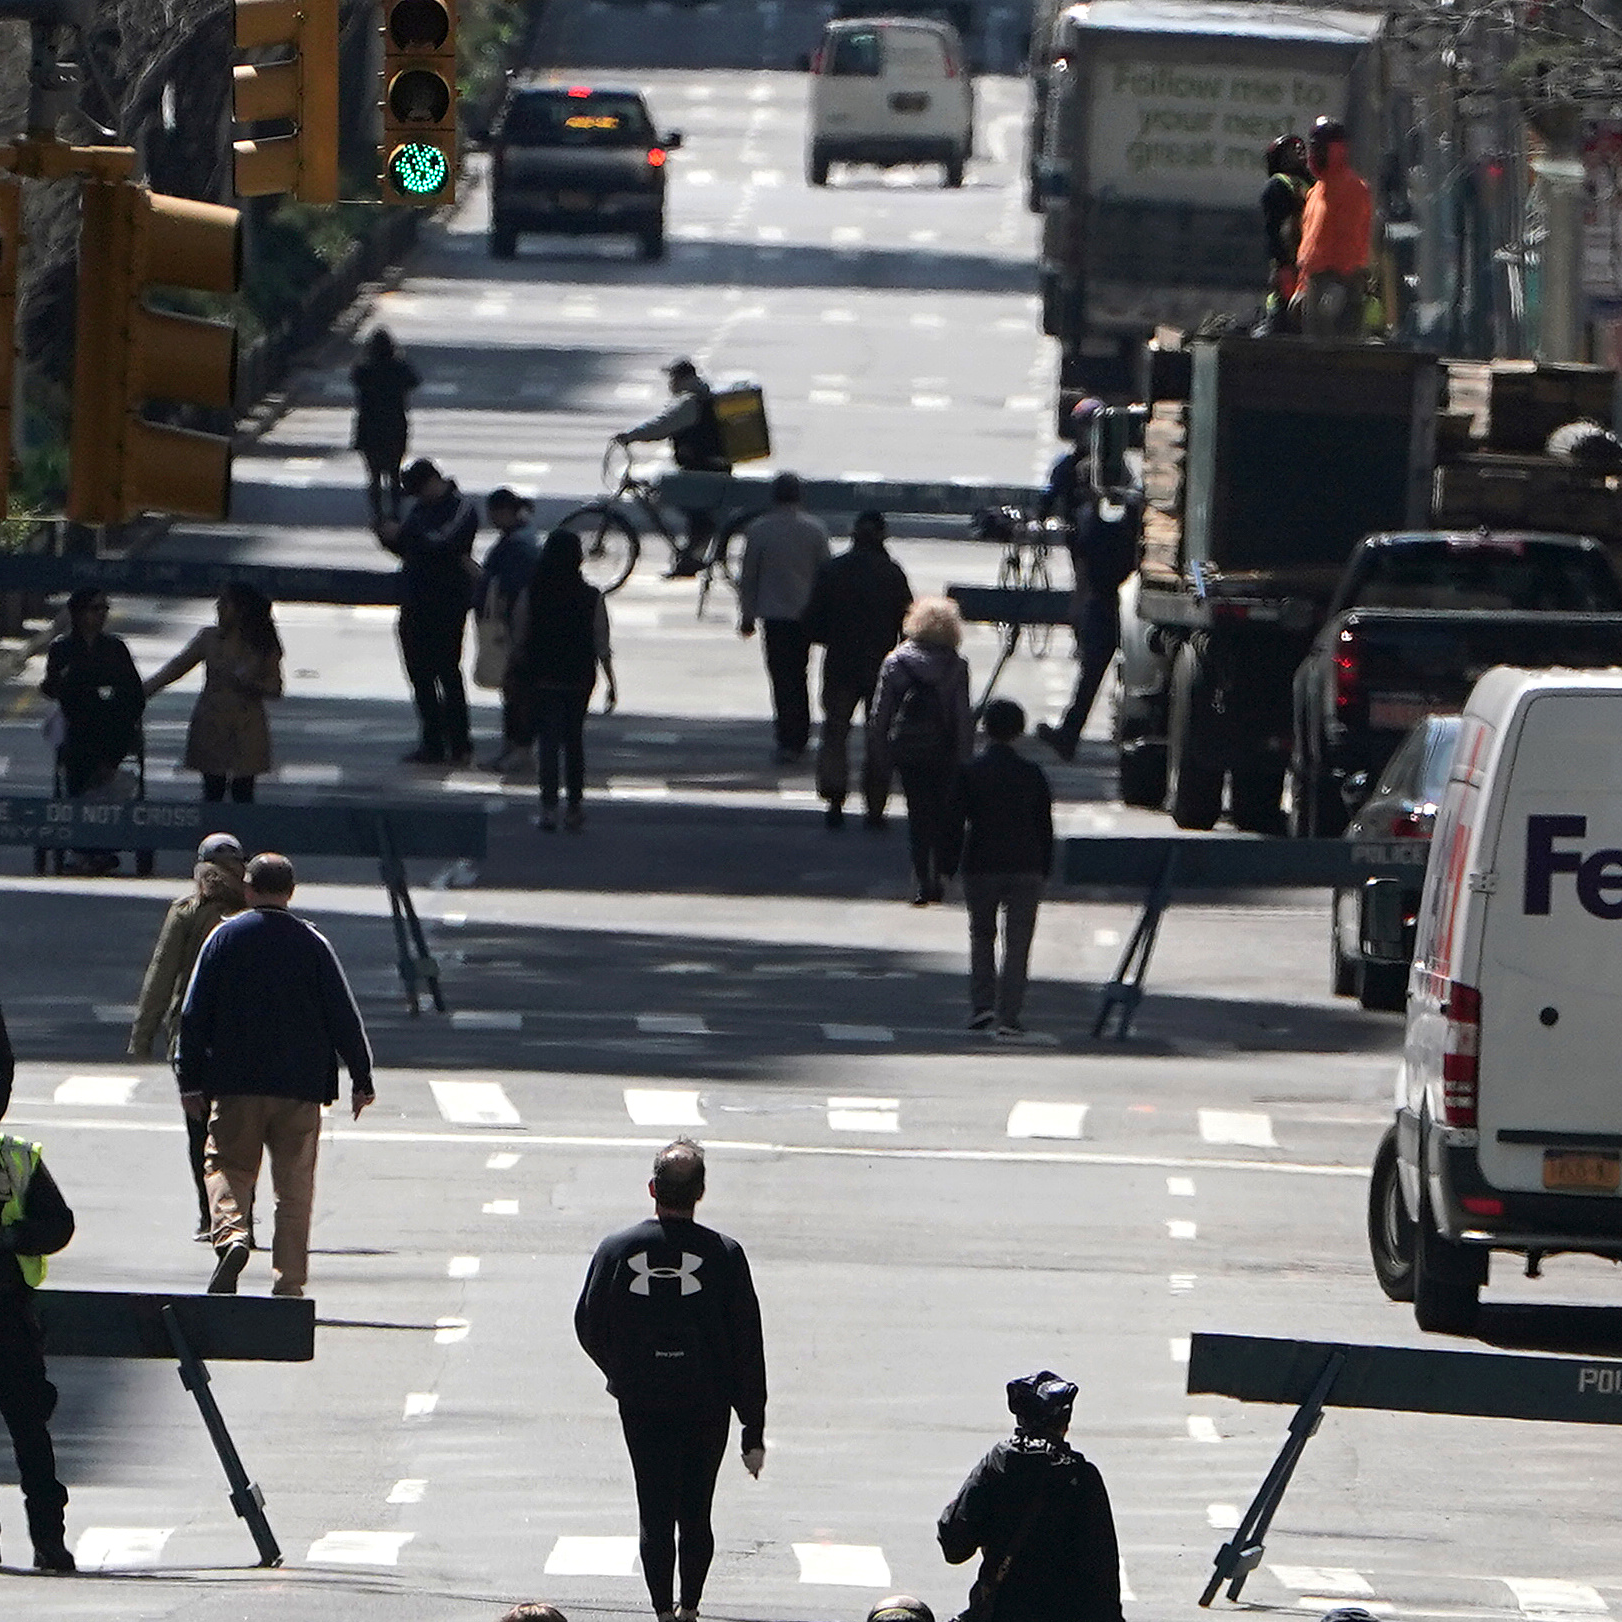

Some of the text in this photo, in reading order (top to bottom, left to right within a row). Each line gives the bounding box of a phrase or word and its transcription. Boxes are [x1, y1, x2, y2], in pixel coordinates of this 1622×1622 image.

[45, 803, 74, 822] DO
[82, 804, 123, 824] NOT
[131, 806, 201, 826] CROSS
